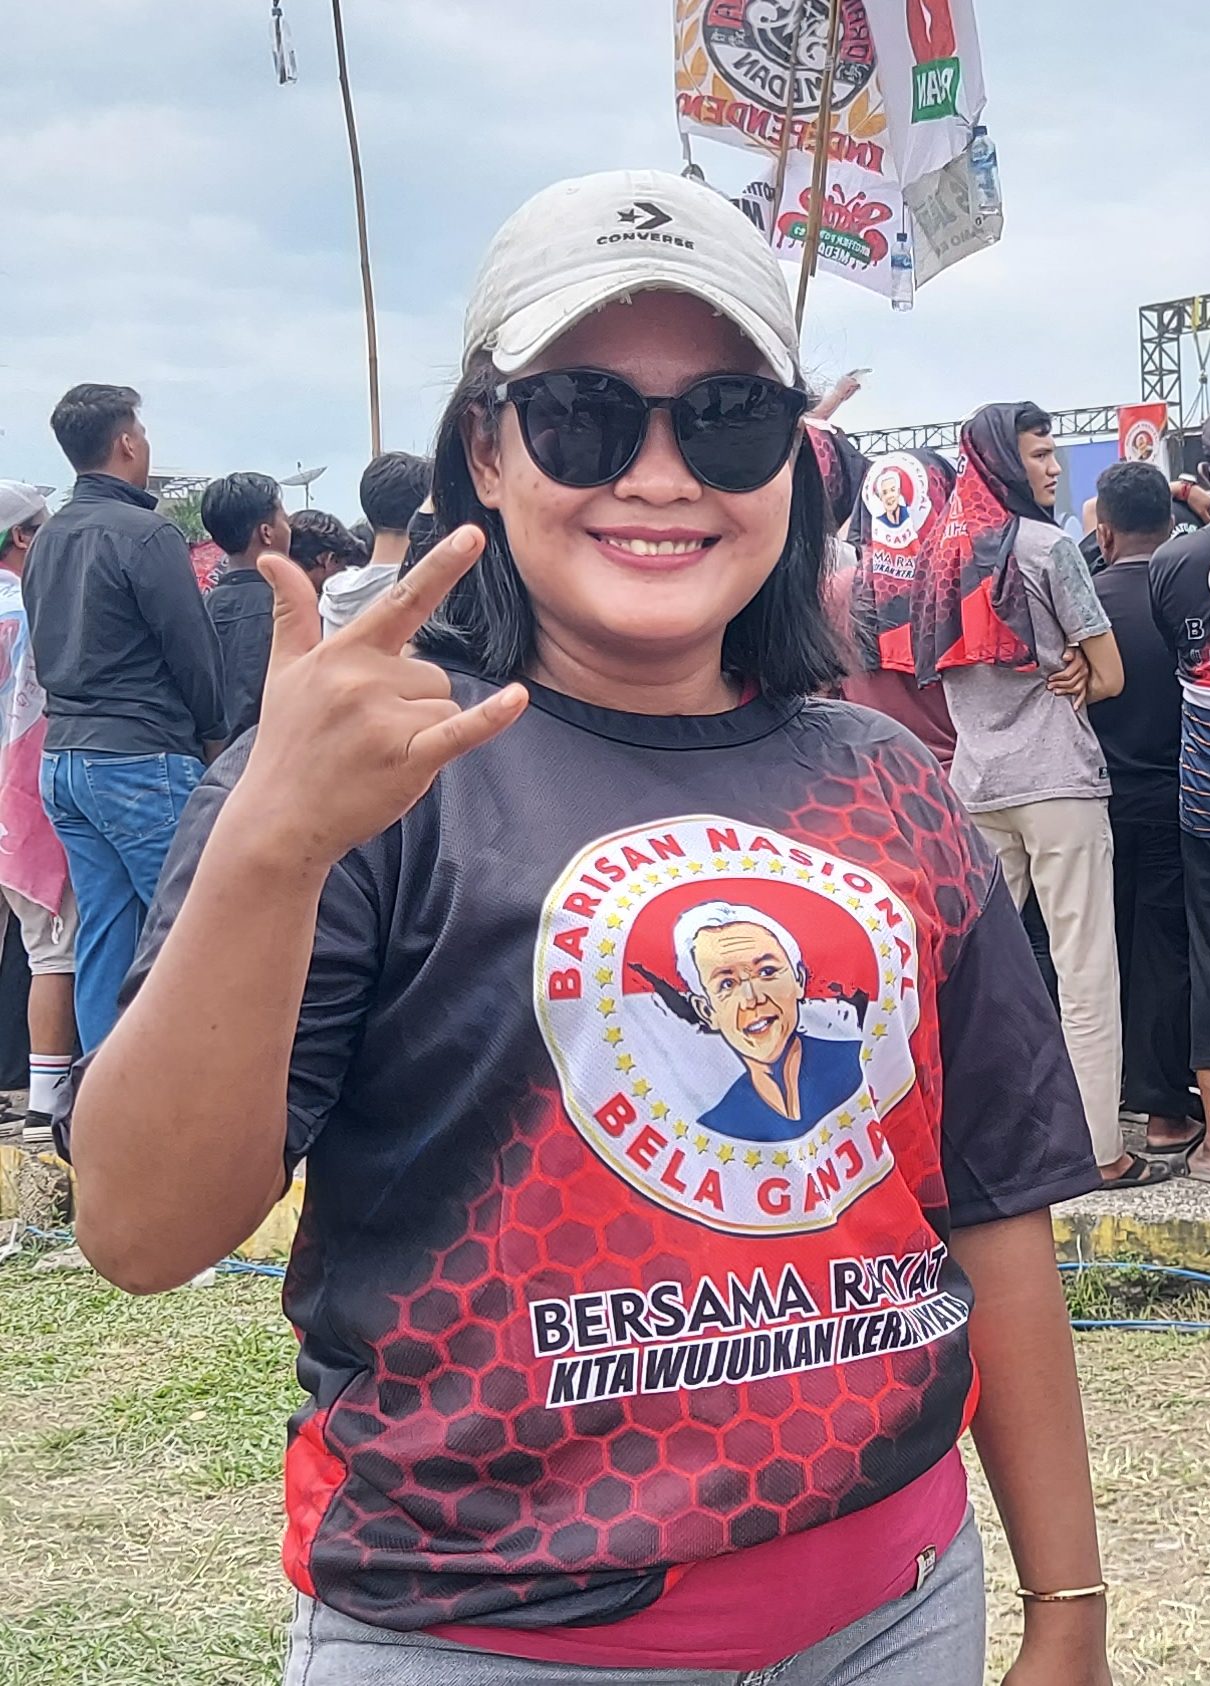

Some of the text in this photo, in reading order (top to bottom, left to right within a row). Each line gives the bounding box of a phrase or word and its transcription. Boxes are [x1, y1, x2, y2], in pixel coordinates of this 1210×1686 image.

[596, 231, 695, 250] CONVERSE
[549, 827, 916, 1002] BARISAN NASIONAL
[593, 1091, 725, 1212] BELA
[531, 1264, 815, 1357] BERSAMA
[547, 1348, 636, 1408] KITA
[642, 1321, 839, 1394] WUJUDKAN
